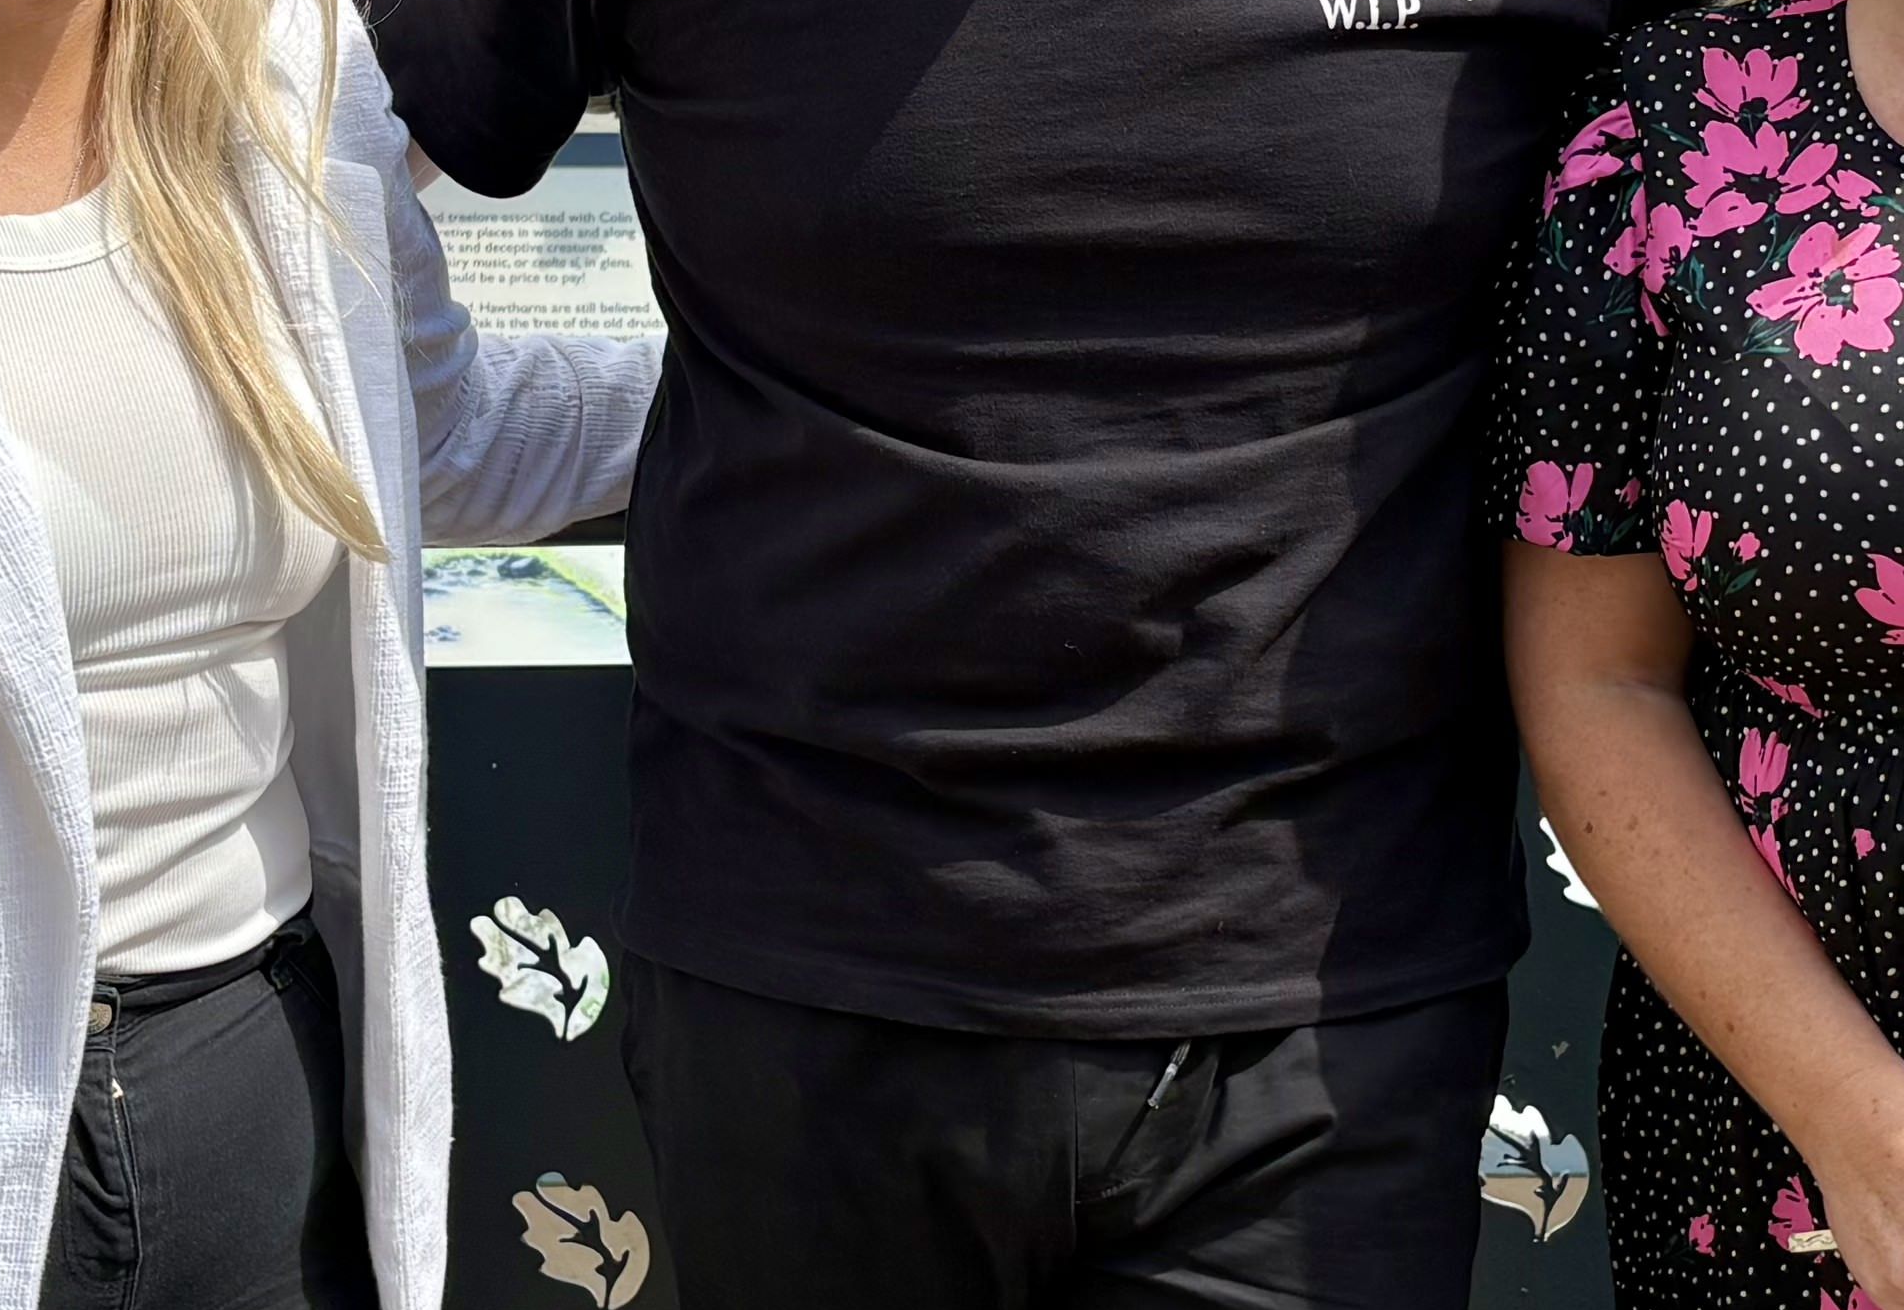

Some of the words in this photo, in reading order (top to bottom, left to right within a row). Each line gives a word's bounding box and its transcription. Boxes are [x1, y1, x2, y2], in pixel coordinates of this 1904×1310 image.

[458, 241, 481, 254] and
[484, 242, 544, 256] deceptive
[546, 244, 607, 253] creatures.
